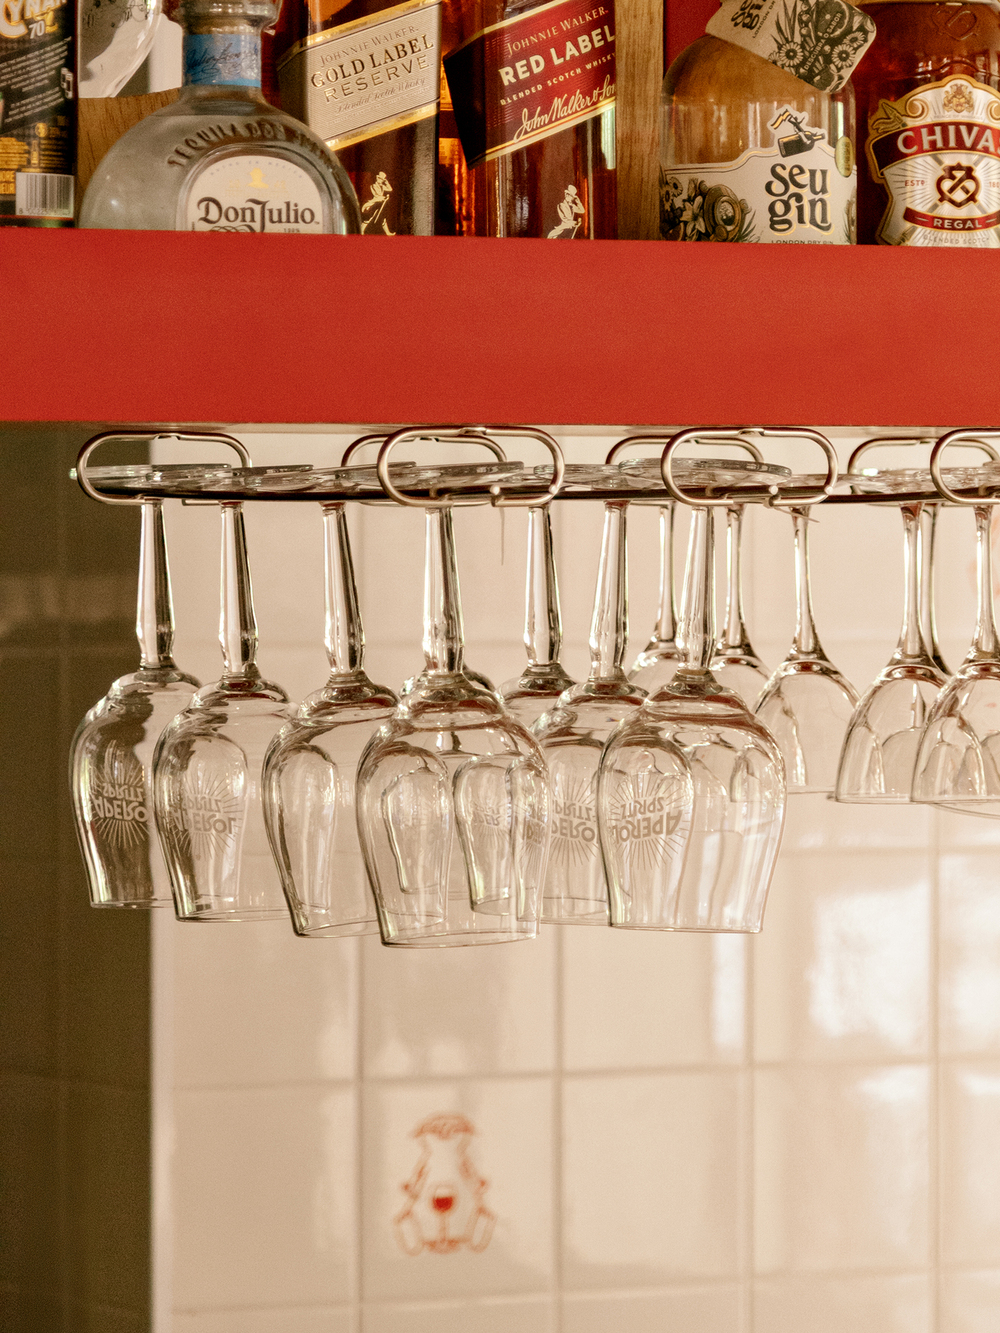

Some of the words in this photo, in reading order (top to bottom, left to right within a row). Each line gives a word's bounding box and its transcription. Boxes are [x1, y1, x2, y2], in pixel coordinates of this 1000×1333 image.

[29, 20, 46, 39] 70
[507, 25, 559, 58] JOHNNIE
[559, 6, 606, 31] WALKER
[752, 10, 771, 39] LONDON
[803, 37, 826, 70] DESCUBRA
[827, 12, 842, 34] SABOR
[310, 58, 365, 88] GOLD
[368, 33, 434, 69] LABEL
[320, 42, 370, 68] JOHNNIE
[371, 25, 416, 46] WALKER
[498, 54, 546, 87] RED
[549, 24, 615, 66] LABEL
[323, 54, 430, 103] RESERVE
[500, 83, 543, 106] BLENDED
[547, 67, 582, 86] SCOTCH
[513, 106, 551, 143] John
[551, 89, 595, 121] Walker
[765, 163, 829, 198] seu
[197, 196, 255, 225] Don
[246, 198, 316, 233] Julio
[768, 191, 832, 233] gin
[933, 218, 983, 229] REGAL
